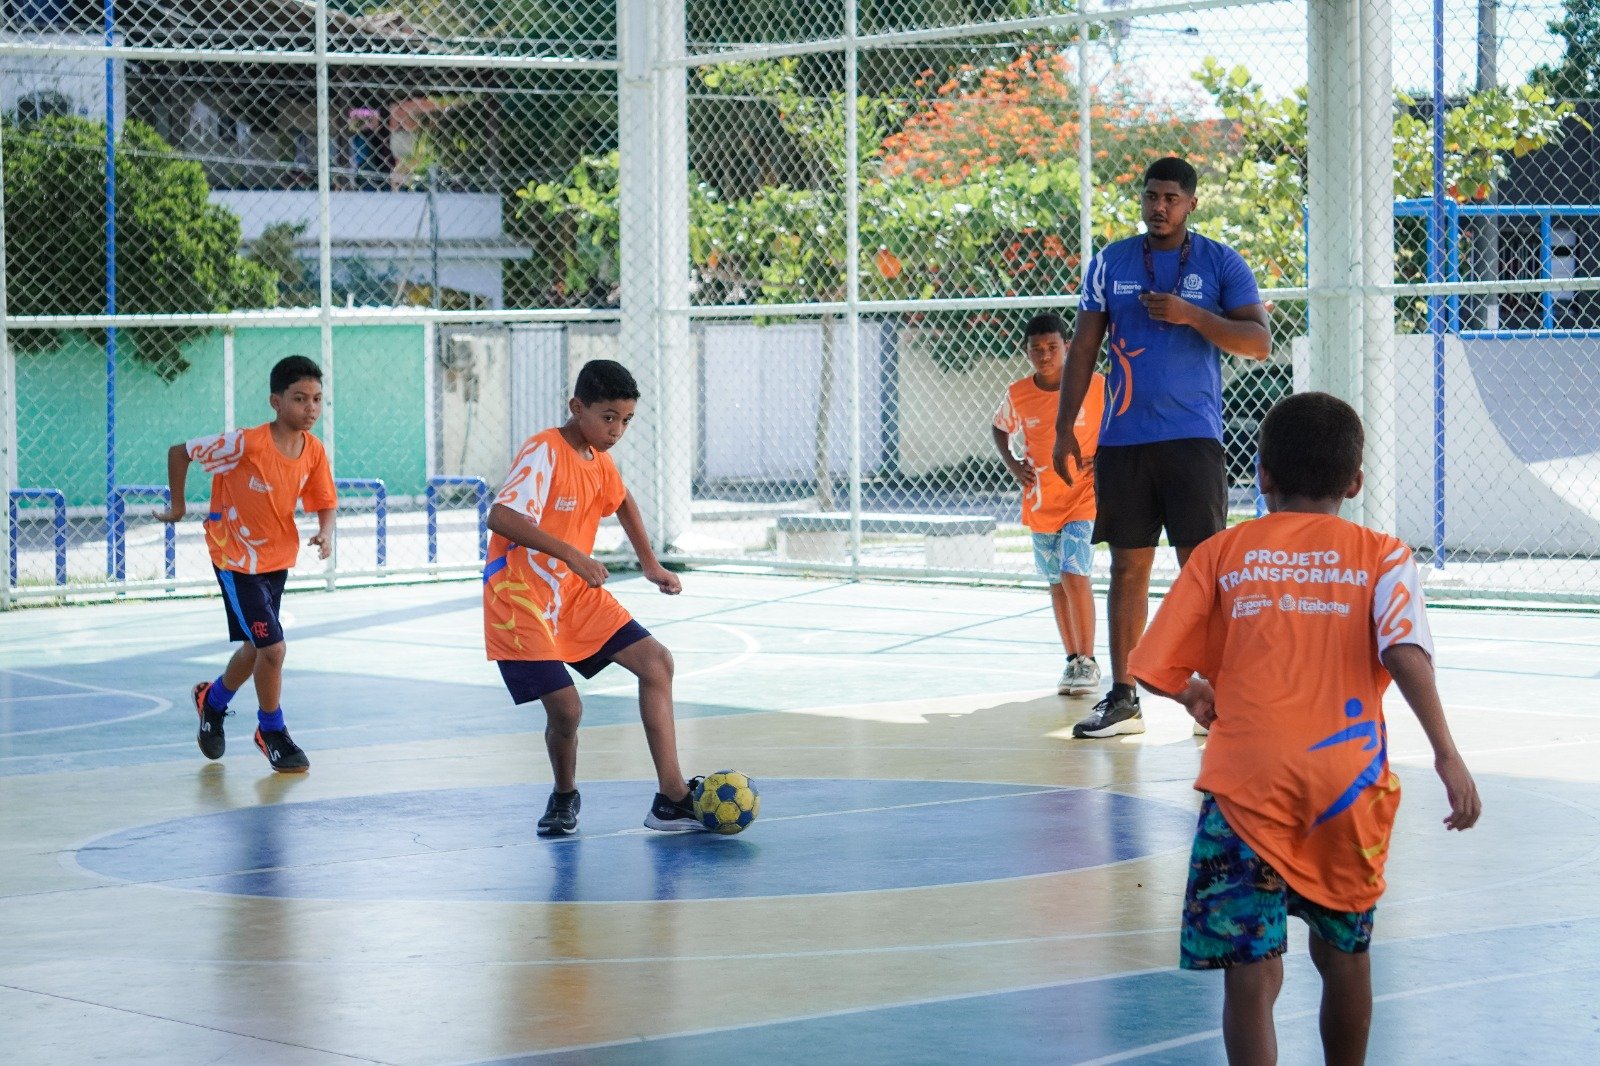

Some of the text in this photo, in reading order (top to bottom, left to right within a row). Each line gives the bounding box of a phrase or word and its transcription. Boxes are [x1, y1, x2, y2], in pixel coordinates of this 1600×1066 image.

[1244, 550, 1339, 566] PROJETO
[1219, 566, 1368, 592] TRANSFORMAR
[1236, 599, 1273, 610] Esporte
